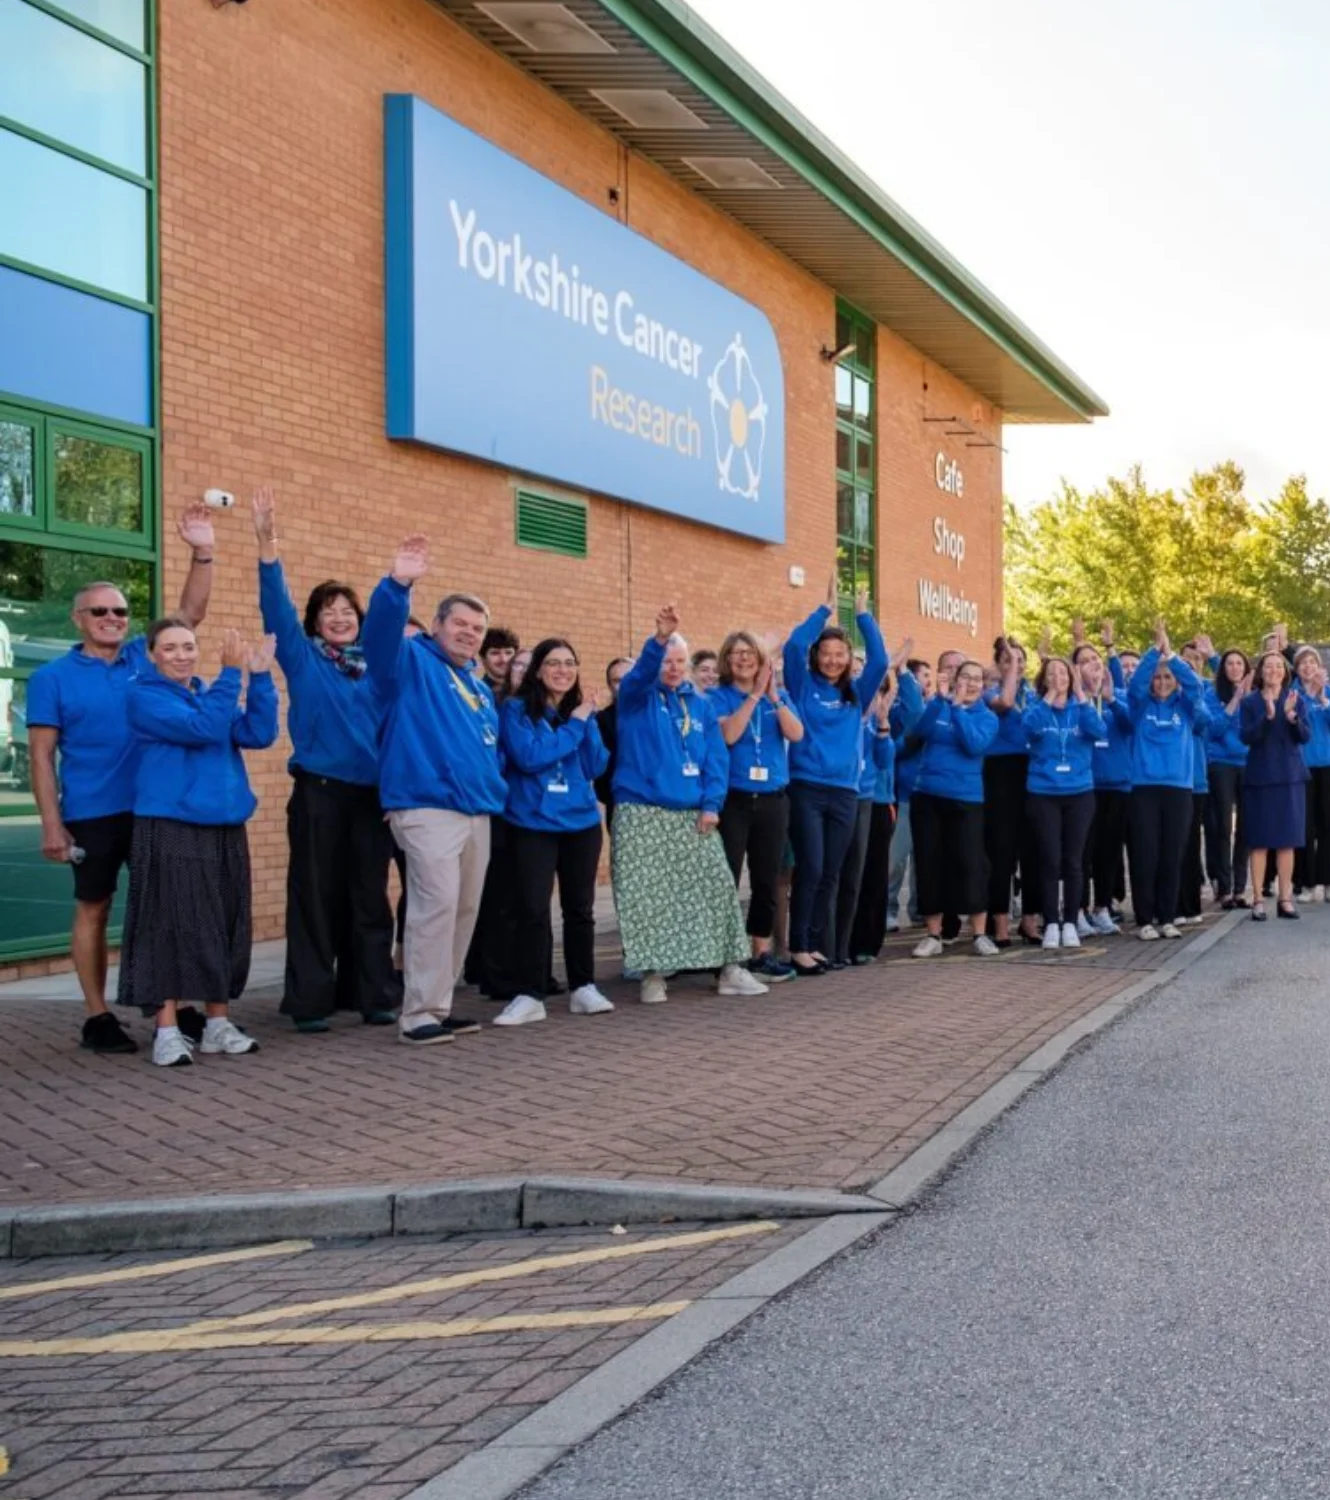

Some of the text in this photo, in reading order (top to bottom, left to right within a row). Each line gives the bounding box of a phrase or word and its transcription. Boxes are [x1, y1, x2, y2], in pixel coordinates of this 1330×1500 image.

[449, 199, 703, 380] Yorkshire Cancer
[590, 366, 701, 459] Research
[935, 451, 964, 498] Cafe
[934, 516, 965, 571] Shop
[918, 577, 977, 637] Wellbeing
